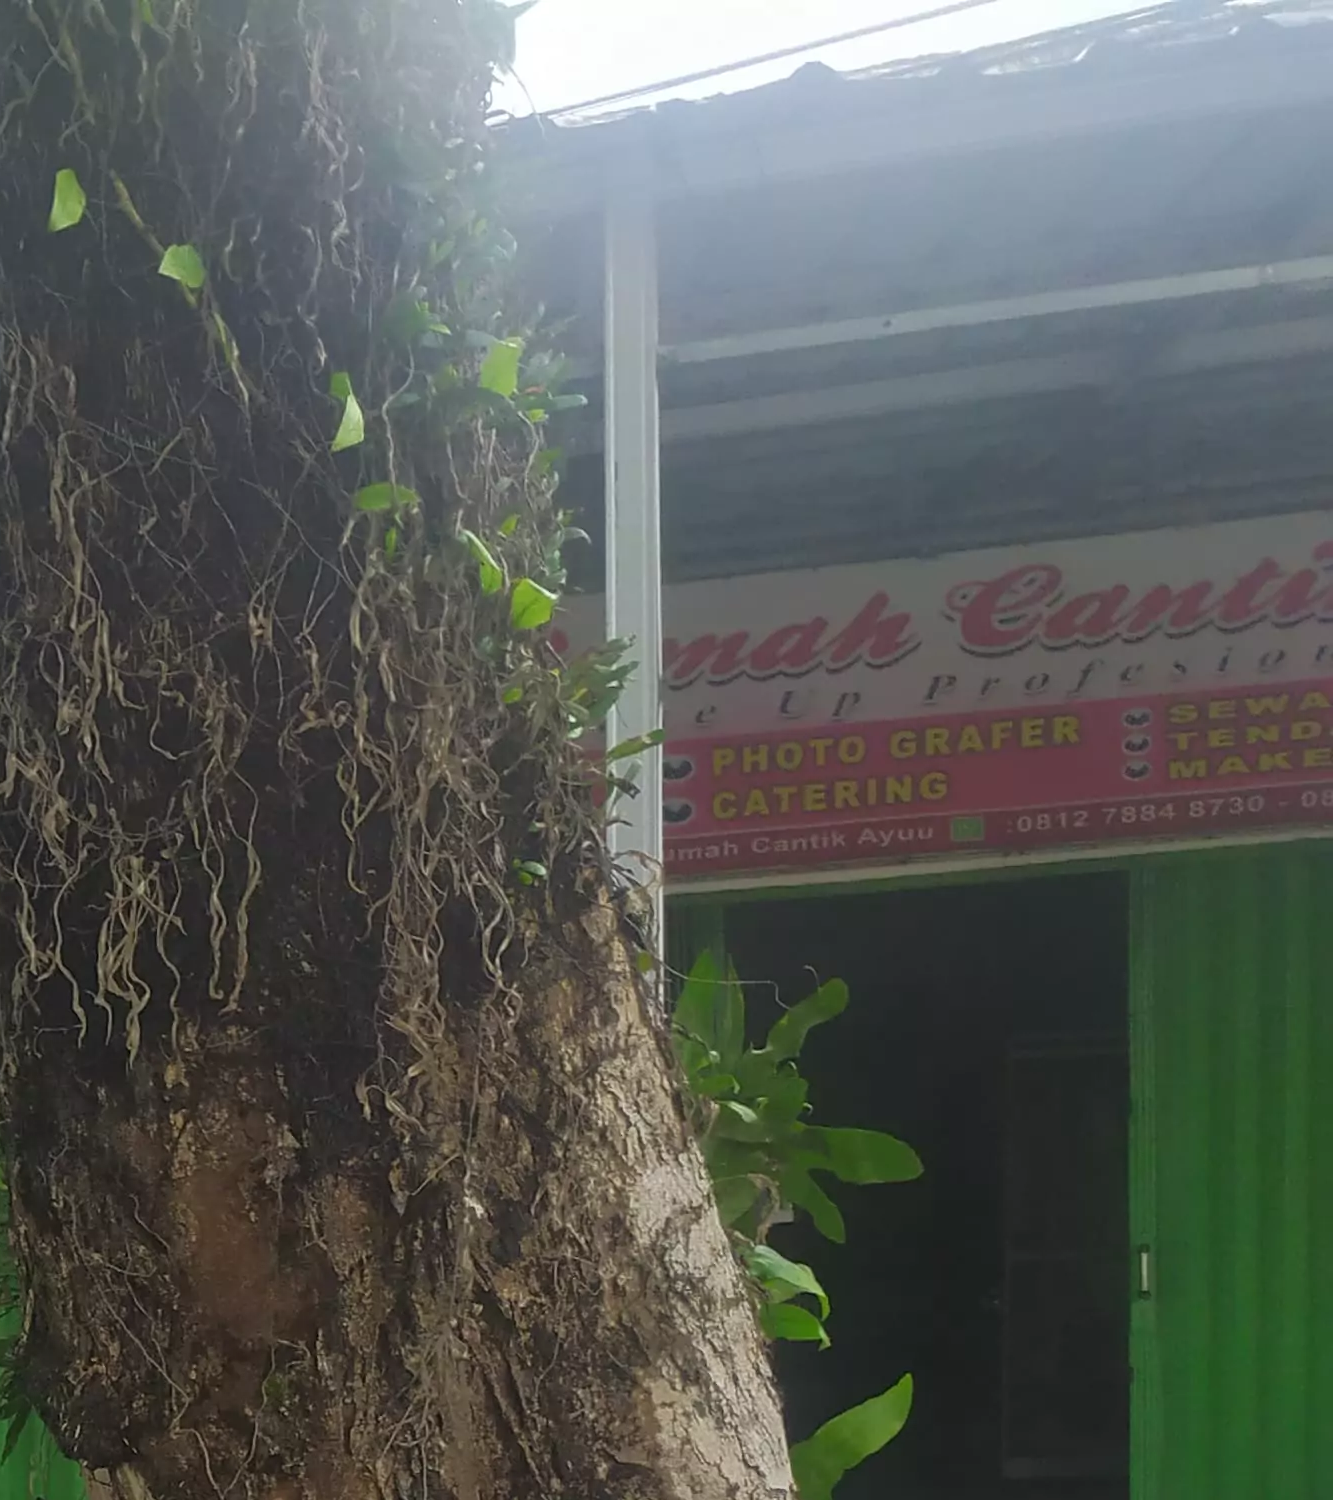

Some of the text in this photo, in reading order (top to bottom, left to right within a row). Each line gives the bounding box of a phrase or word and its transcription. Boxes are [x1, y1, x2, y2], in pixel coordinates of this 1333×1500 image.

[942, 540, 1333, 658] Canti
[1167, 690, 1333, 725] SEWA
[711, 714, 1081, 778] PHOTO GRAFER
[1167, 720, 1333, 752] TEND
[711, 771, 950, 820] CATERING
[750, 831, 847, 855] Cantik
[856, 826, 935, 849] Ayuu
[1101, 801, 1177, 826] 7884
[1188, 794, 1265, 820] 8730
